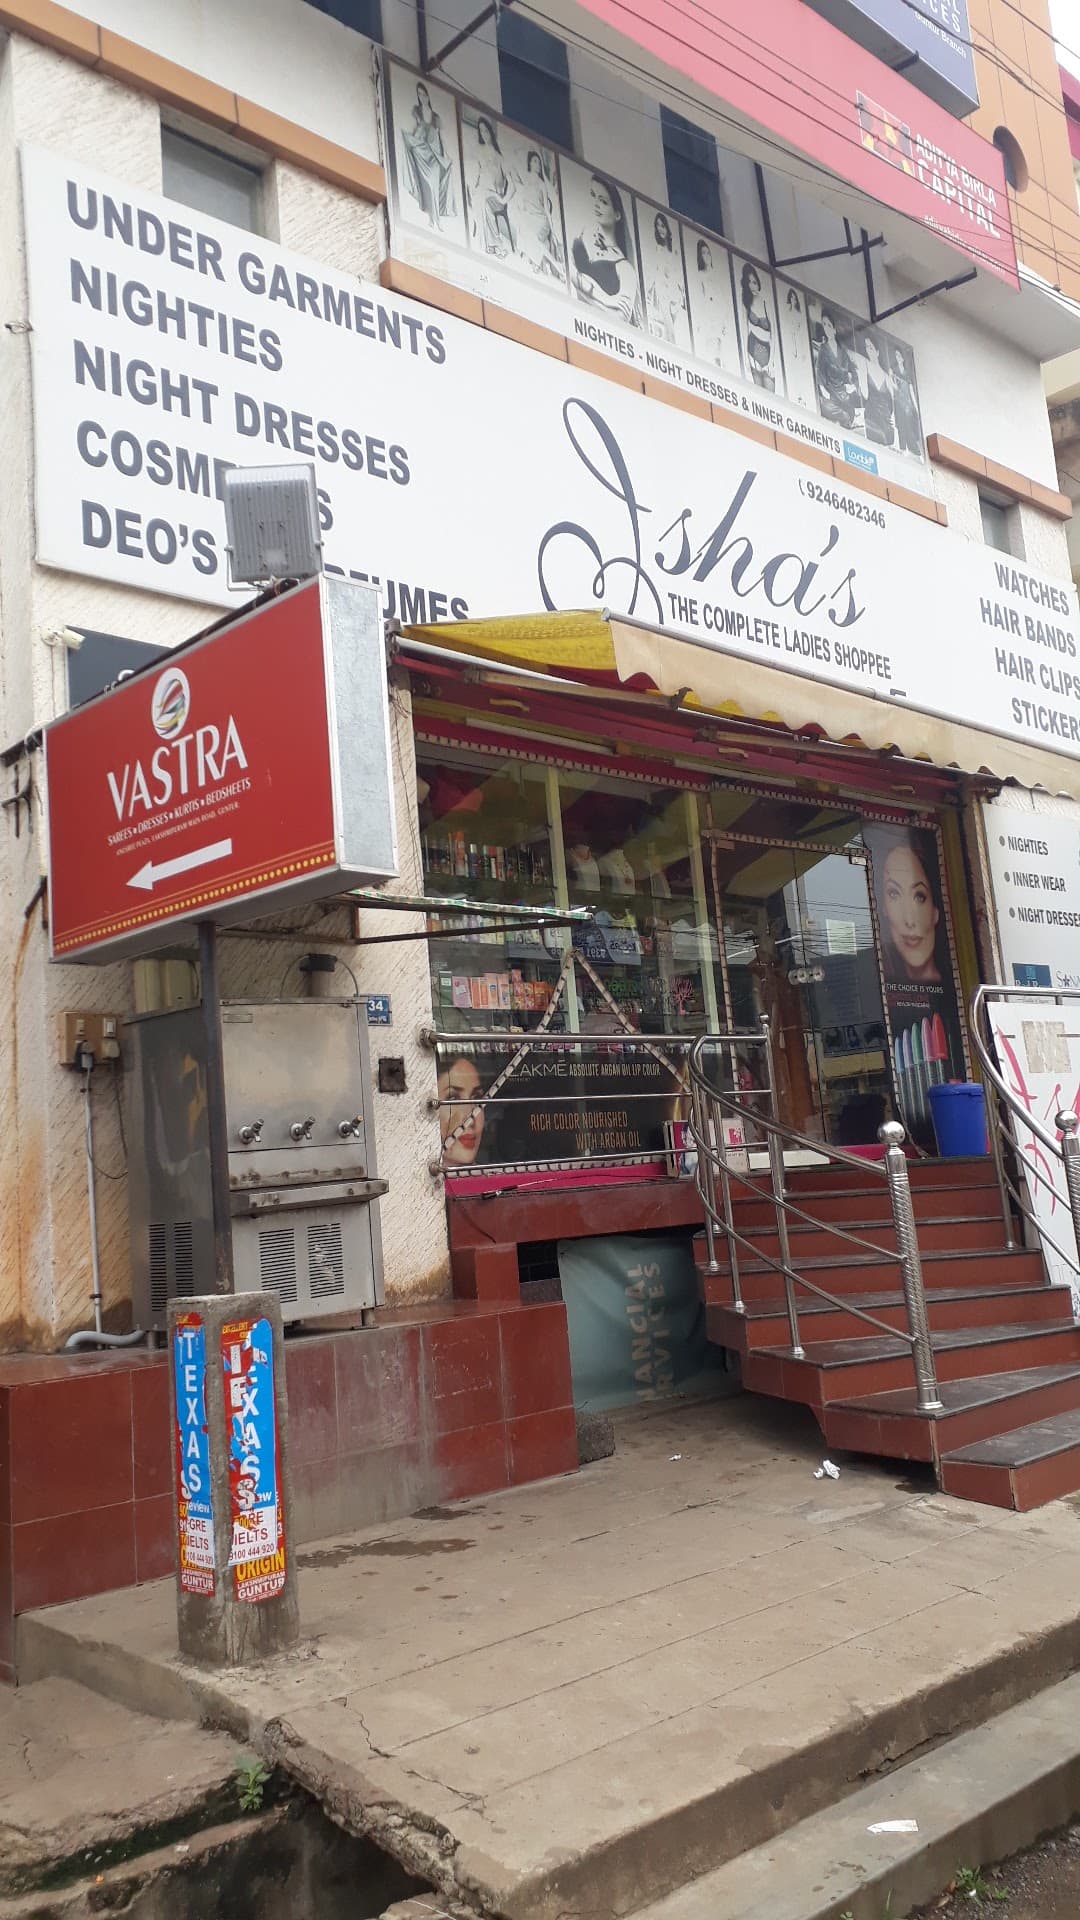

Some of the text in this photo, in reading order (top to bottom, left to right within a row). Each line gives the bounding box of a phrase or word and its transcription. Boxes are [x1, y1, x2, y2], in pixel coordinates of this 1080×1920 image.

[941, 30, 967, 60] Branch
[917, 158, 1001, 239] CAPITAL
[961, 166, 996, 208] BIRLA
[66, 180, 446, 364] UNDER GARMENTS
[70, 258, 283, 372] NIGHTIES
[574, 318, 635, 360] NIGHTIES
[646, 352, 682, 381] NIGHT
[686, 370, 738, 407] DRESSES
[741, 396, 749, 412] &
[752, 400, 784, 427] INNER
[786, 417, 841, 454] GARMENTS
[74, 339, 410, 486] NIGHT DRESSES
[77, 420, 333, 531] COSMES
[806, 481, 886, 529] 9246482346
[81, 500, 218, 575] DEO'S
[994, 561, 1069, 616] WATCHES
[668, 592, 892, 680] THE COMPLETE LADIES SHOPPEE
[980, 597, 1077, 658] HAIR BANDS
[995, 647, 1080, 701] HAIR CLIPS
[1011, 697, 1080, 742] STICKER
[107, 714, 249, 822] VASTRA
[107, 777, 252, 847] SAREES DRESSES KURTIS BEDSHEETS
[1008, 835, 1049, 856] NIGHTIES
[1013, 871, 1067, 893] INNER WEAR
[1018, 907, 1044, 924] NIGHT
[887, 983, 944, 994] THE CHOICE IS YOURS
[569, 1063, 600, 1077] ABSOLUTE
[601, 1063, 621, 1077] ARGAN
[632, 1063, 641, 1077] LIP
[642, 1062, 661, 1077] COLOR
[530, 1111, 628, 1132] RICH COLOR NOURISHED
[575, 1130, 642, 1152] WITH ARGAN OIL
[182, 1331, 203, 1493] TEXAS
[187, 1535, 210, 1551] IELTS
[189, 1518, 207, 1533] GRE
[234, 1527, 269, 1547] IELTS
[235, 1547, 286, 1581] ORIGIN
[247, 1545, 261, 1557] 444
[261, 1542, 275, 1554] 920
[181, 1574, 215, 1591] GUNTUR
[237, 1577, 286, 1599] GUNTUR
